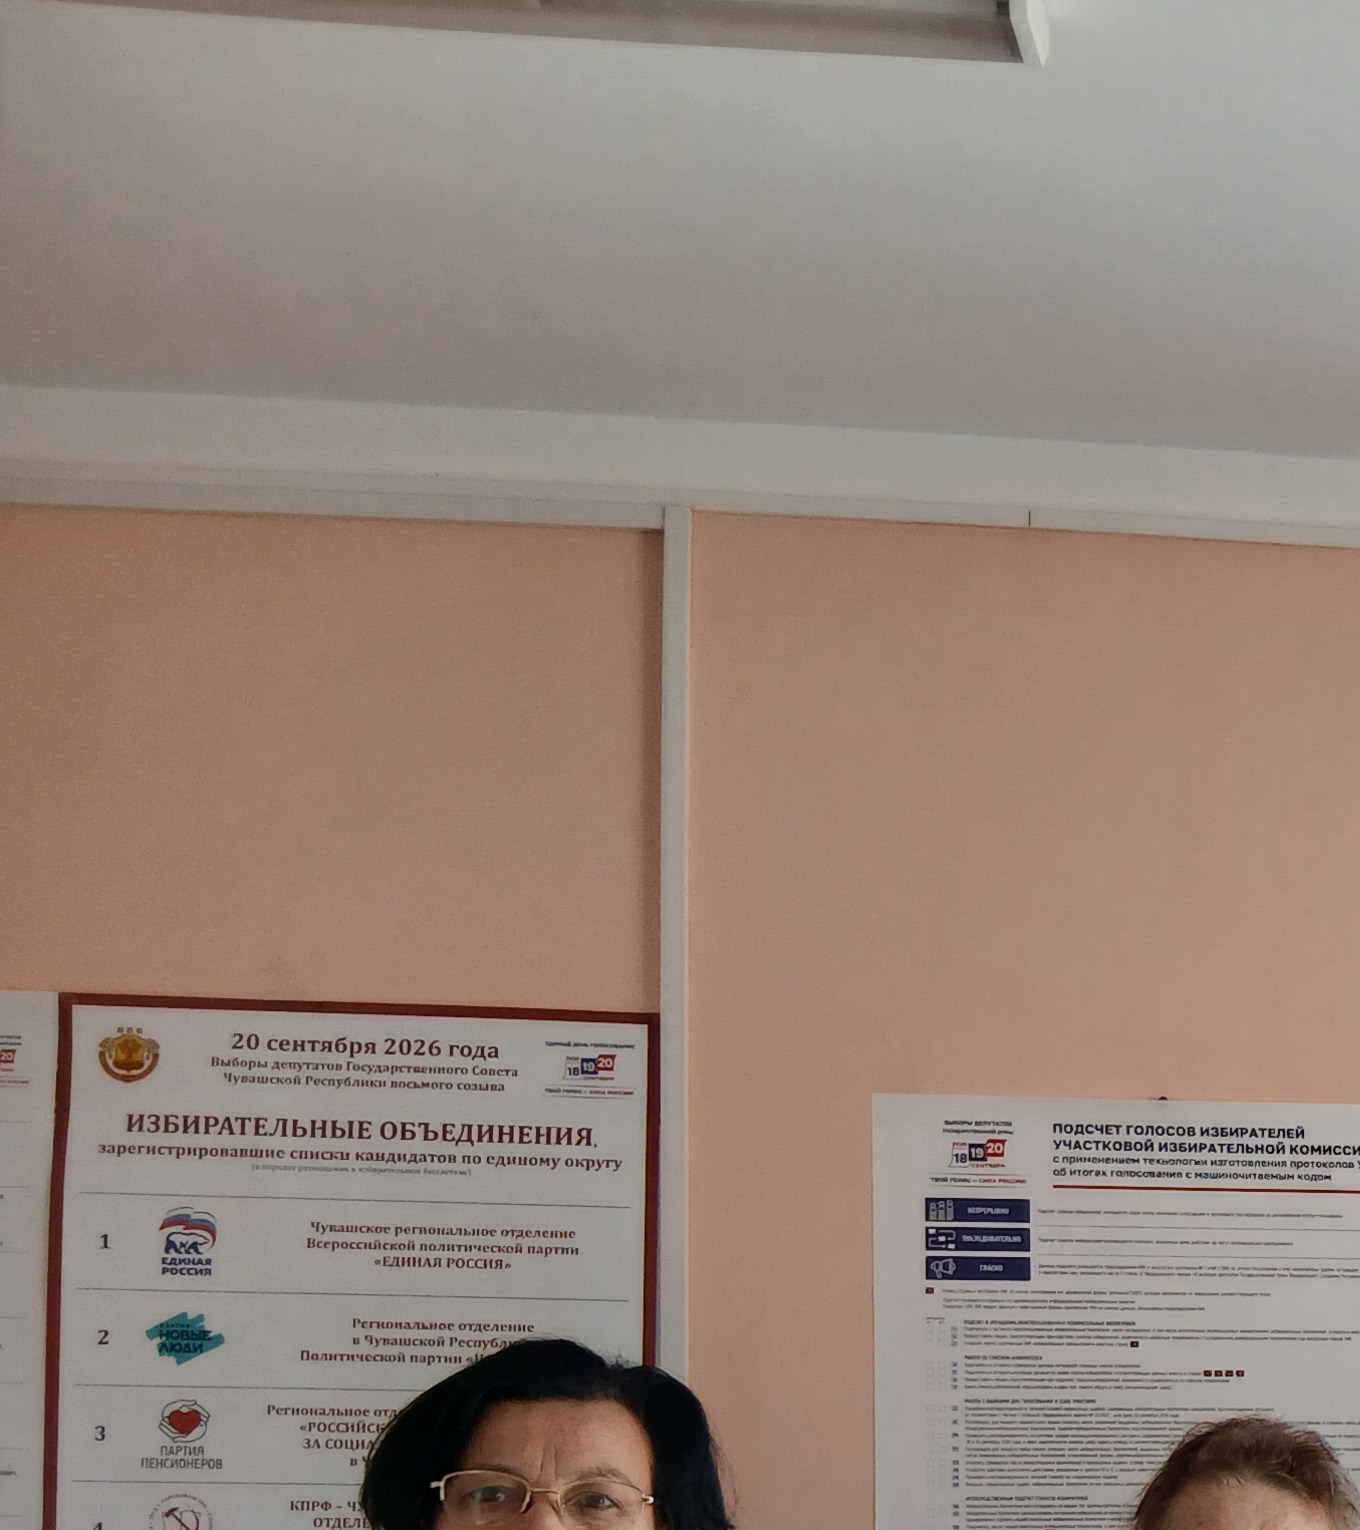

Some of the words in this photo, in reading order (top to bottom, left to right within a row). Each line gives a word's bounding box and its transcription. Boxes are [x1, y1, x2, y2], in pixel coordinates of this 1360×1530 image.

[230, 1032, 261, 1051] 20
[266, 1037, 378, 1058] сентября
[383, 1038, 442, 1057] 2026
[448, 1042, 501, 1062] года
[210, 1056, 268, 1071] Выборы
[271, 1059, 344, 1073] депутатов
[223, 1072, 302, 1088] Чувашской
[305, 1075, 387, 1091] Республики
[126, 1113, 373, 1140] ИЗБИРАТЕЛЬНЫЕ
[380, 1120, 598, 1149] ОБЪЕДИНЕНИЯ,
[1052, 1123, 1122, 1136] ПОДСЧЕТ
[1125, 1124, 1197, 1137] ГОЛОСОВ
[1200, 1125, 1305, 1140] ИЗБИРАТЕЛЕЙ
[953, 1153, 968, 1164] 18
[970, 1147, 985, 1159] 19
[986, 1142, 1004, 1154] 20
[1053, 1139, 1154, 1153] УЧАСТКОВОЙ
[1158, 1141, 1286, 1155] ИЗБИРАТЕЛЬНОЙ
[98, 1143, 287, 1160] зарегистрировавшие
[289, 1149, 351, 1162] списки
[355, 1151, 458, 1165] кандидатов
[461, 1154, 482, 1165] по
[486, 1155, 560, 1171] единому
[564, 1157, 623, 1172] округу
[1062, 1156, 1140, 1166] применением
[1142, 1157, 1208, 1166] технологии
[1210, 1159, 1287, 1168] изготовления
[1289, 1160, 1355, 1170] протоколов
[1052, 1167, 1067, 1177] об
[1069, 1168, 1107, 1177] итогах
[1110, 1169, 1183, 1179] голосования
[1194, 1171, 1295, 1182] машиночитаемым
[1297, 1173, 1332, 1182] кодом
[310, 1221, 391, 1236] Чувашское
[394, 1226, 498, 1239] региональное
[500, 1227, 577, 1240] отделение
[100, 1233, 111, 1250] 1
[306, 1237, 416, 1252] Всероссийской
[419, 1240, 523, 1255] политической
[527, 1246, 580, 1258] партии
[161, 1257, 212, 1266] ЕДИНАЯ
[374, 1255, 443, 1268] «ЕДИНАЯ
[446, 1257, 513, 1270] РОССИЯ»
[161, 1267, 212, 1276] РОССИЯ
[352, 1318, 455, 1331] Региональное
[458, 1322, 535, 1333] отделение
[97, 1329, 110, 1345] 2
[158, 1329, 213, 1341] НОВЫЕ
[352, 1337, 360, 1346] в
[364, 1334, 446, 1349] Чувашской
[157, 1341, 205, 1354] ЛЮДИ
[300, 1350, 405, 1364] Политической
[410, 1353, 463, 1366] партии
[267, 1404, 371, 1417] Региональное
[94, 1425, 106, 1442] 3
[160, 1445, 205, 1457] ПАРТИЯ
[302, 1438, 321, 1450] ЗА
[140, 1457, 223, 1470] ПЕНСИОНЕРОВ
[290, 1500, 332, 1512] КПРФ
